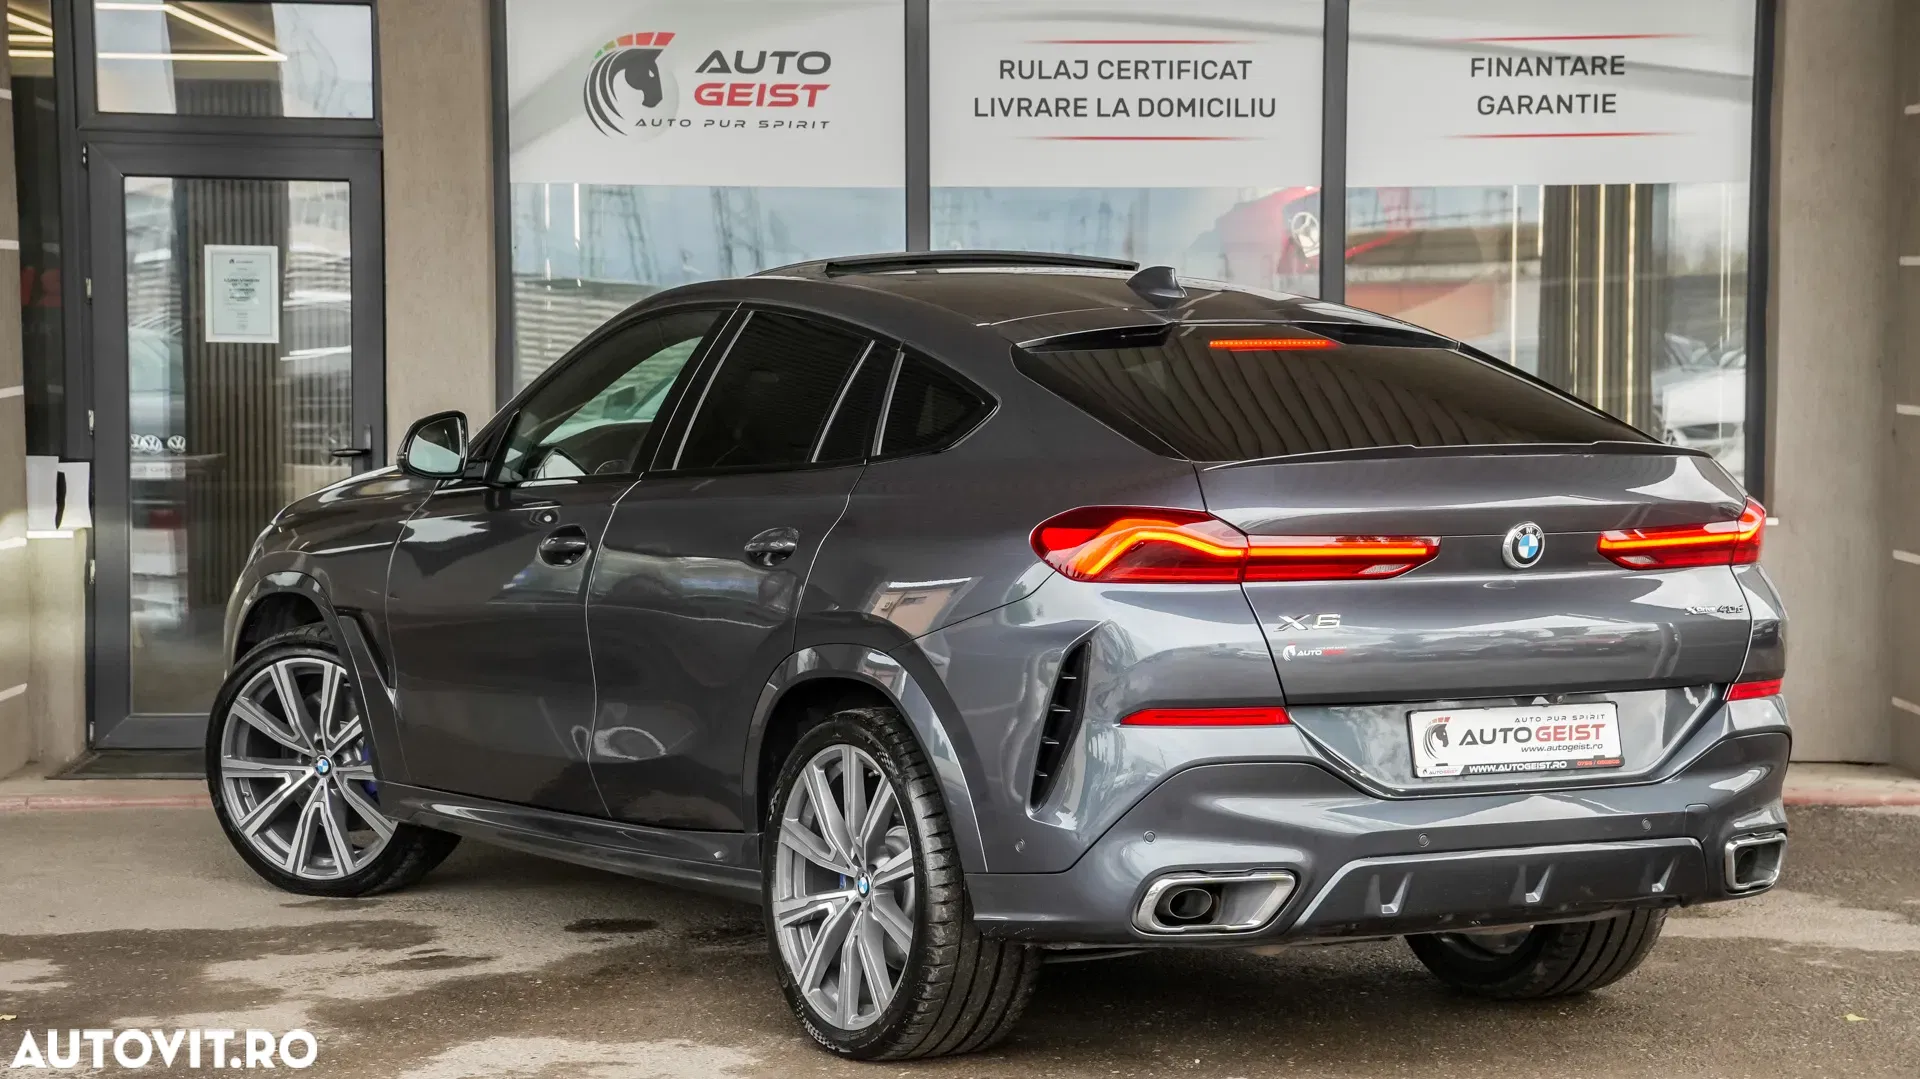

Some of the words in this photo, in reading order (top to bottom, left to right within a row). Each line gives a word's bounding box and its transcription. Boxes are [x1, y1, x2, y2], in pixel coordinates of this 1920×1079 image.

[695, 49, 832, 75] AUTO
[999, 59, 1089, 80] RULAJ
[1096, 59, 1253, 80] CERTIFICAT
[1470, 55, 1626, 77] FINANTARE
[693, 82, 831, 108] GEIST
[1477, 93, 1617, 115] GARANTIE
[973, 97, 1088, 118] LIVRARE
[1096, 97, 1130, 118] LA
[1138, 97, 1276, 118] DOMICILIU
[634, 118, 692, 128] AUTO
[703, 119, 746, 129] PUR
[758, 120, 831, 130] SPIRIT
[1273, 612, 1341, 632] X6
[1520, 743, 1604, 753] www.autogeist.ro
[1469, 760, 1568, 773] WWW.AUTOGEIST.RO
